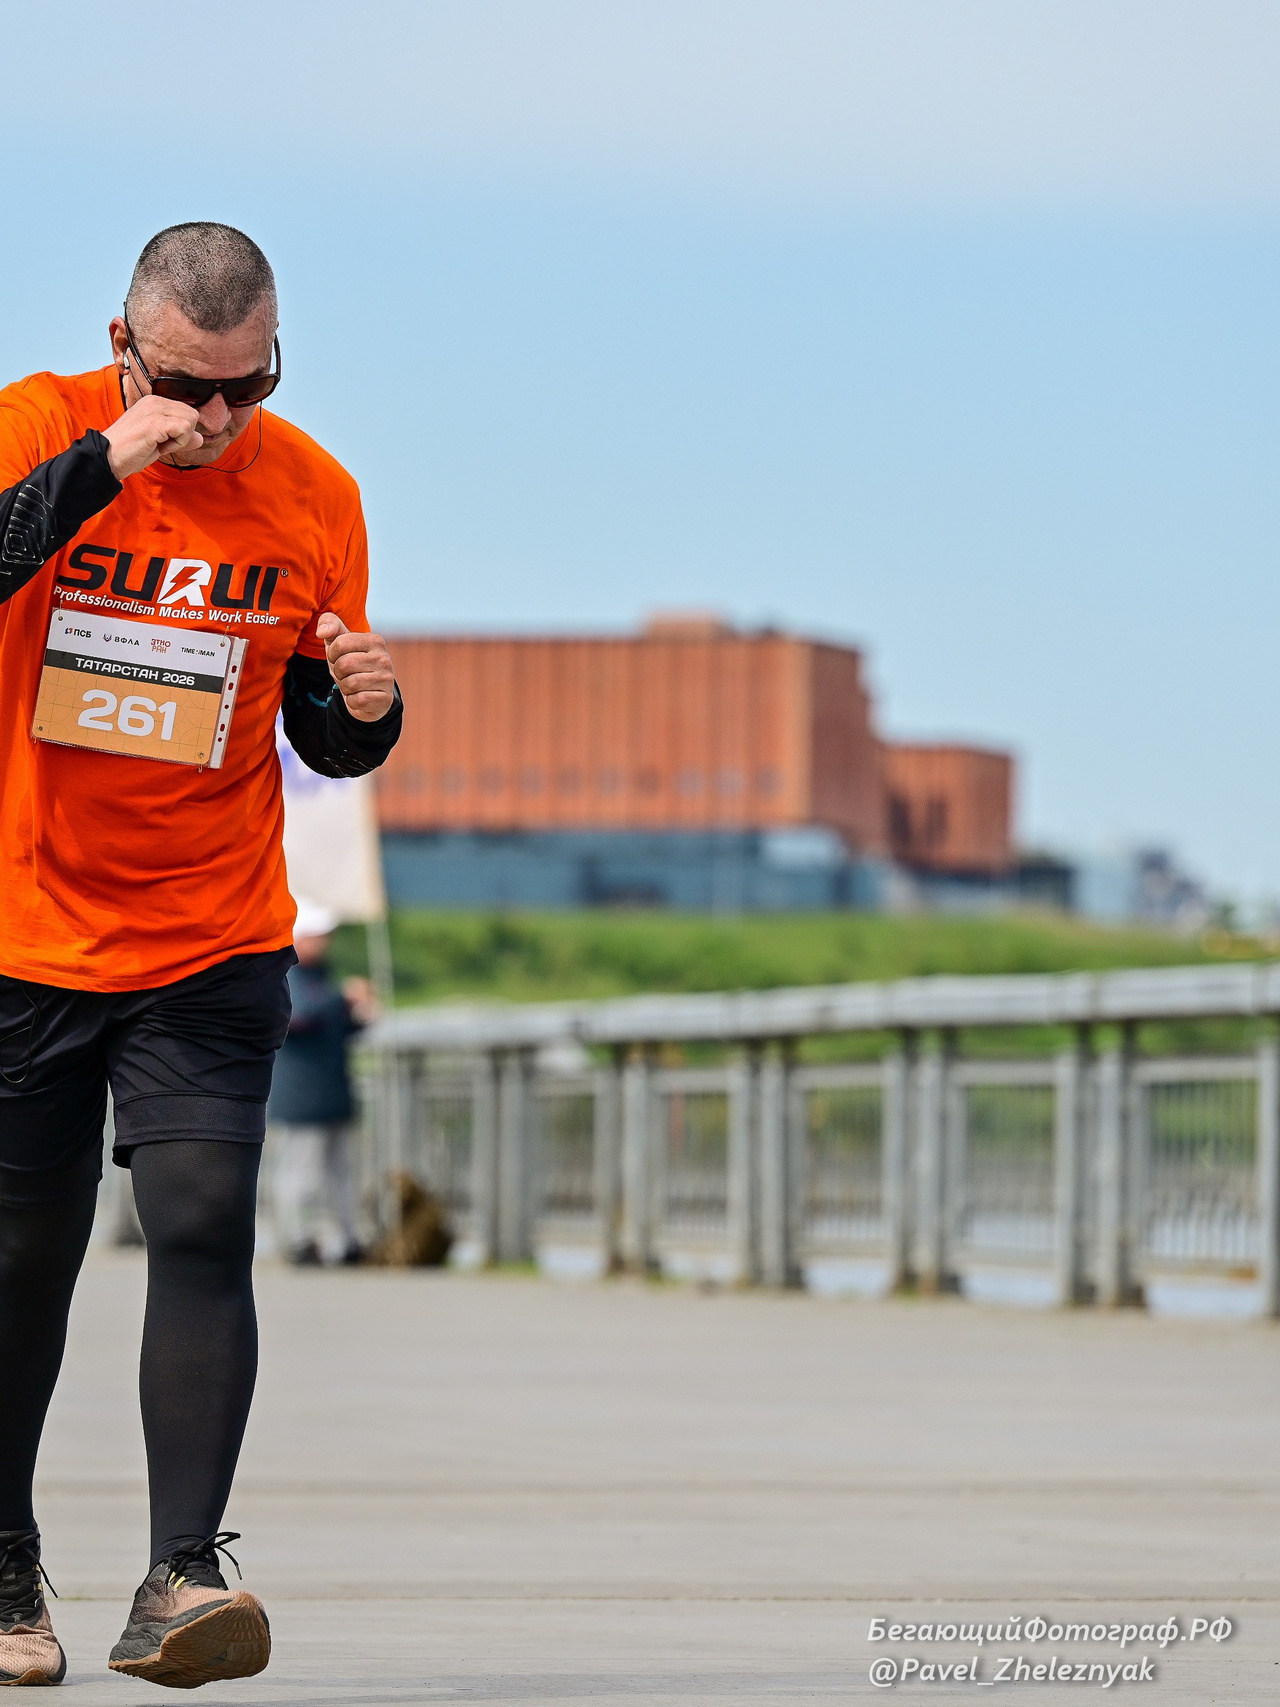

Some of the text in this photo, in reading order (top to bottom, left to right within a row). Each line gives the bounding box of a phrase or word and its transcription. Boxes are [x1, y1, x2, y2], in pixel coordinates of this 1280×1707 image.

[53, 585, 280, 626] Professionalism Makes Work Easier
[73, 628, 92, 638] ПСБ
[114, 636, 140, 646] ВФЛА
[75, 657, 195, 686] ТАТАРСТАН 2026
[77, 689, 177, 741] 261
